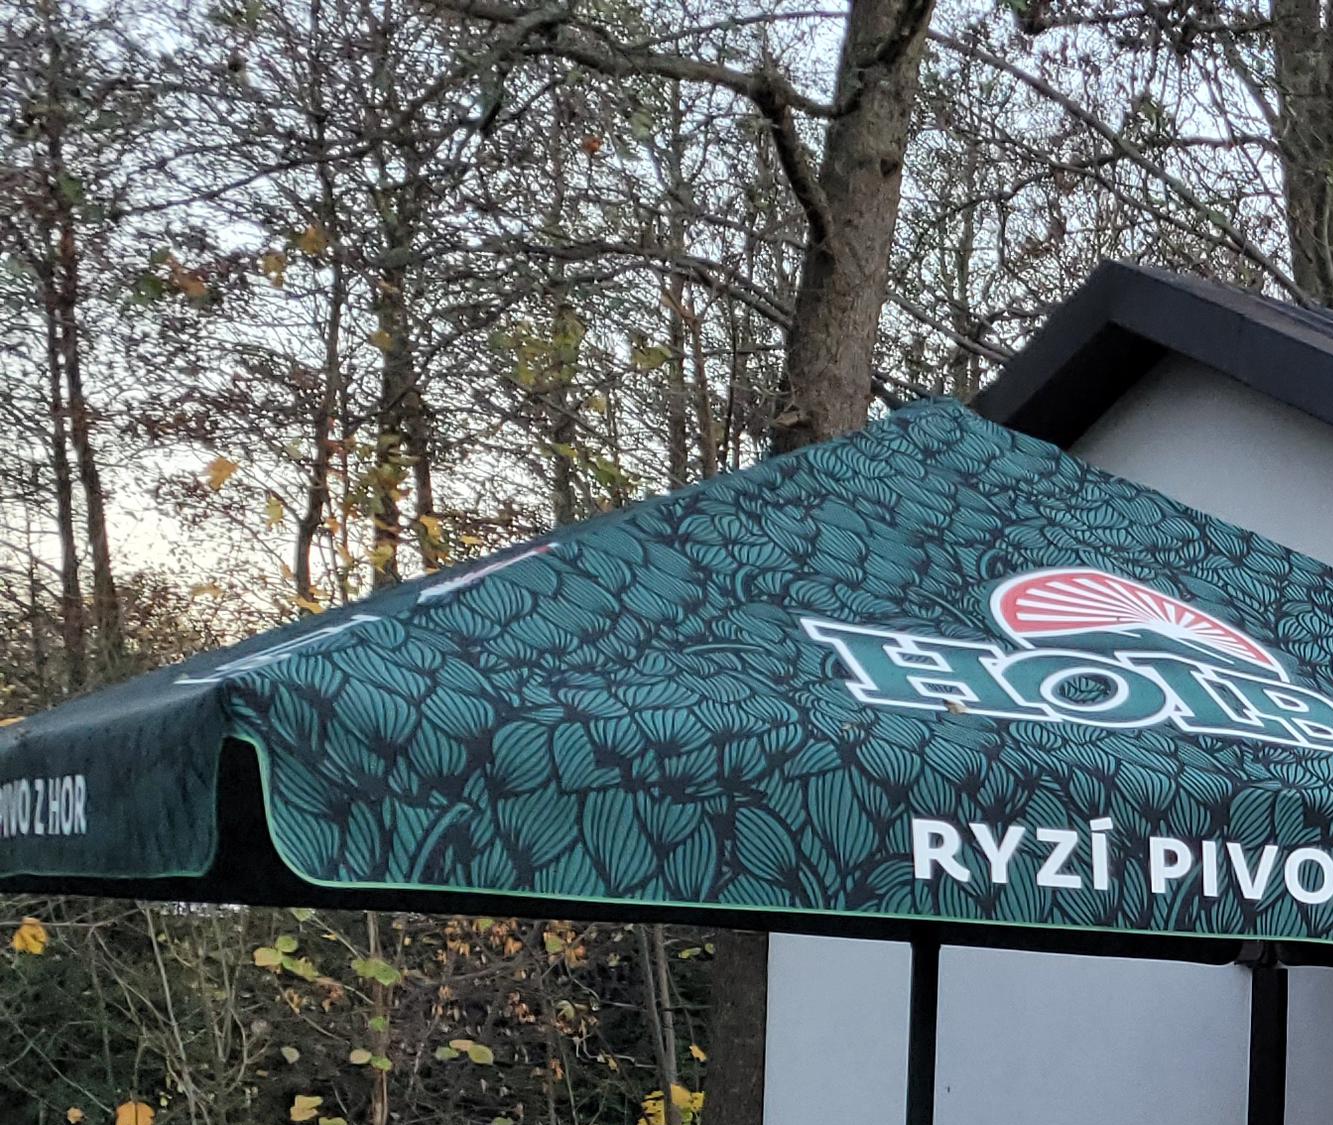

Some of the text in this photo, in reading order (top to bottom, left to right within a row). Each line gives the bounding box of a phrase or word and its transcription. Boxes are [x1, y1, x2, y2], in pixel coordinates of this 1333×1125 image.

[34, 778, 45, 835] Z
[48, 774, 88, 836] HOR
[911, 817, 1113, 892] RYZÍ
